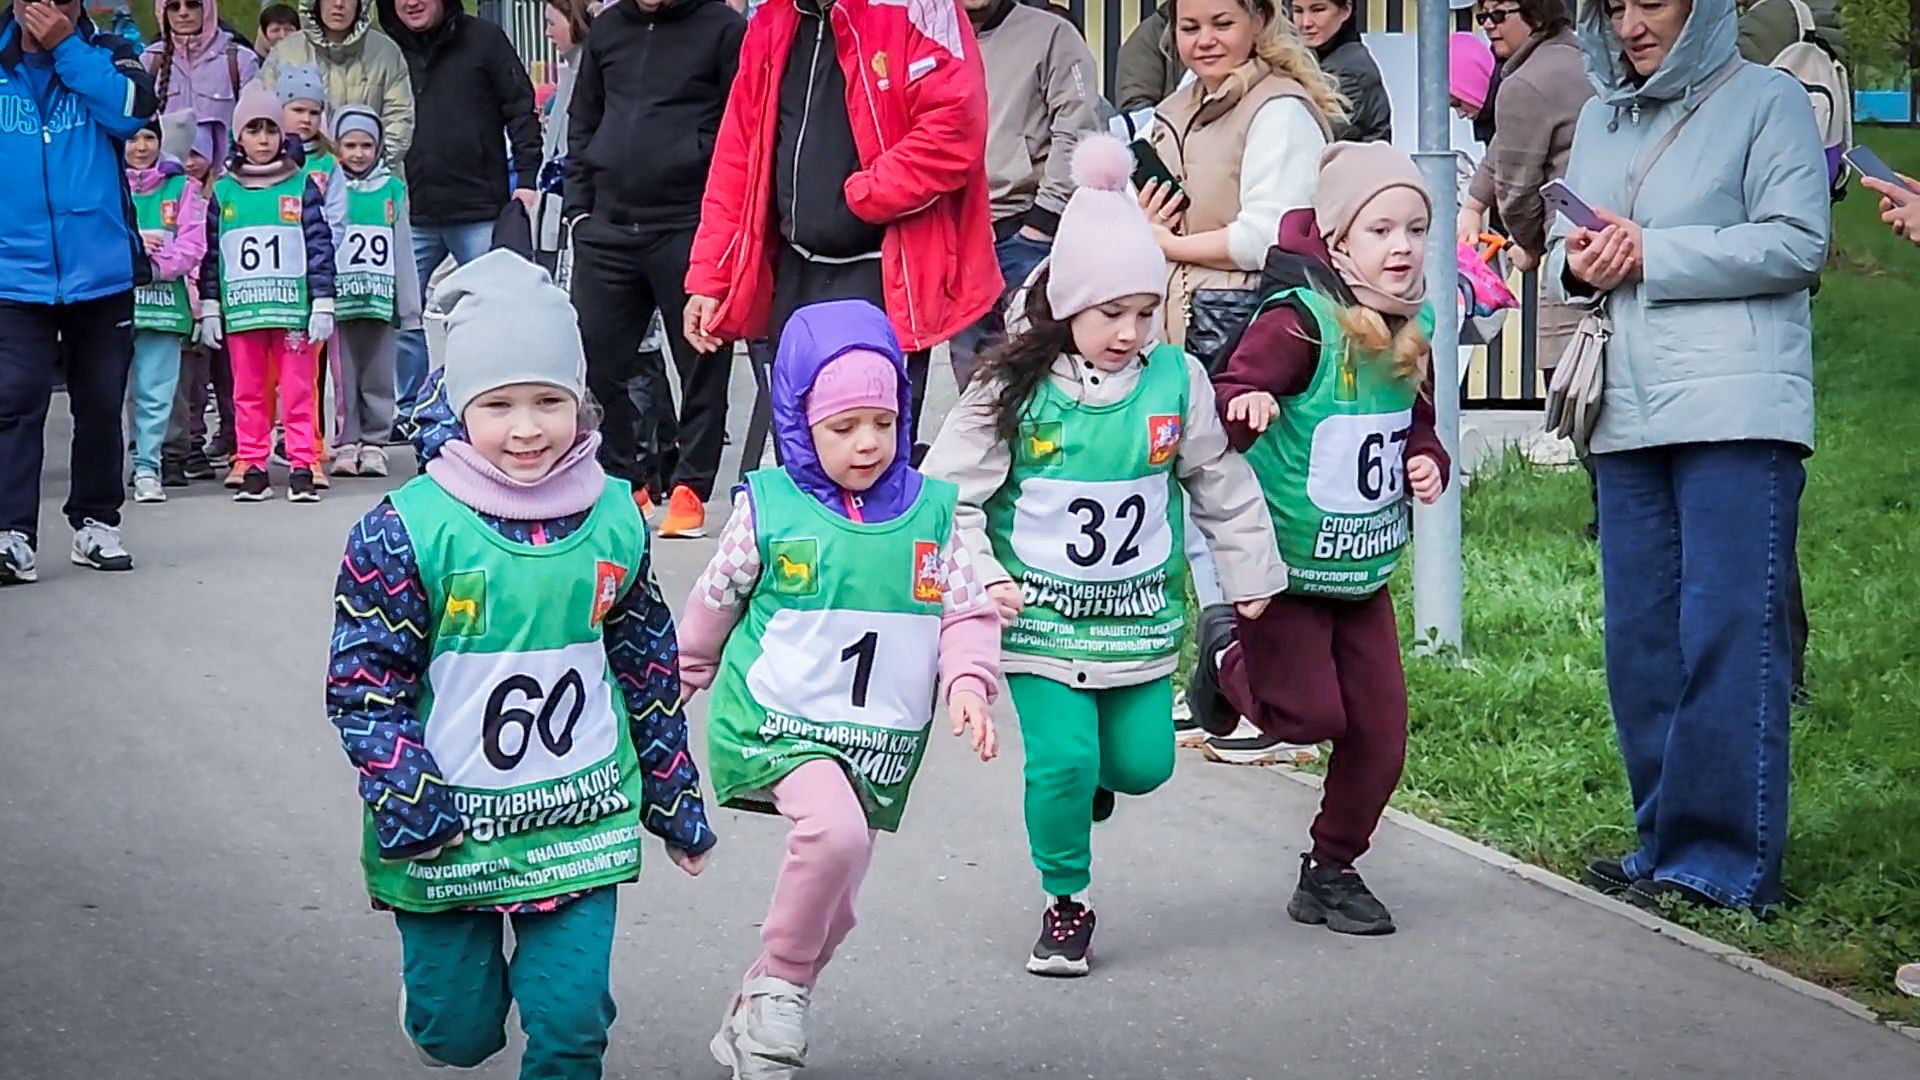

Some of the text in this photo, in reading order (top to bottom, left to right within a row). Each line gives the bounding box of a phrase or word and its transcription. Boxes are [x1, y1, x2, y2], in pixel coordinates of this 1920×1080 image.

[240, 235, 280, 270] 61
[349, 233, 388, 266] 29
[134, 289, 176, 306] НИЦЫ
[227, 287, 299, 306] БРОННИЦЫ
[1357, 428, 1409, 500] 67
[1066, 494, 1146, 567] 32
[840, 631, 878, 708] 1
[482, 667, 587, 771] 60
[451, 761, 620, 817] ОРТИВНЫЙ КЛУБ
